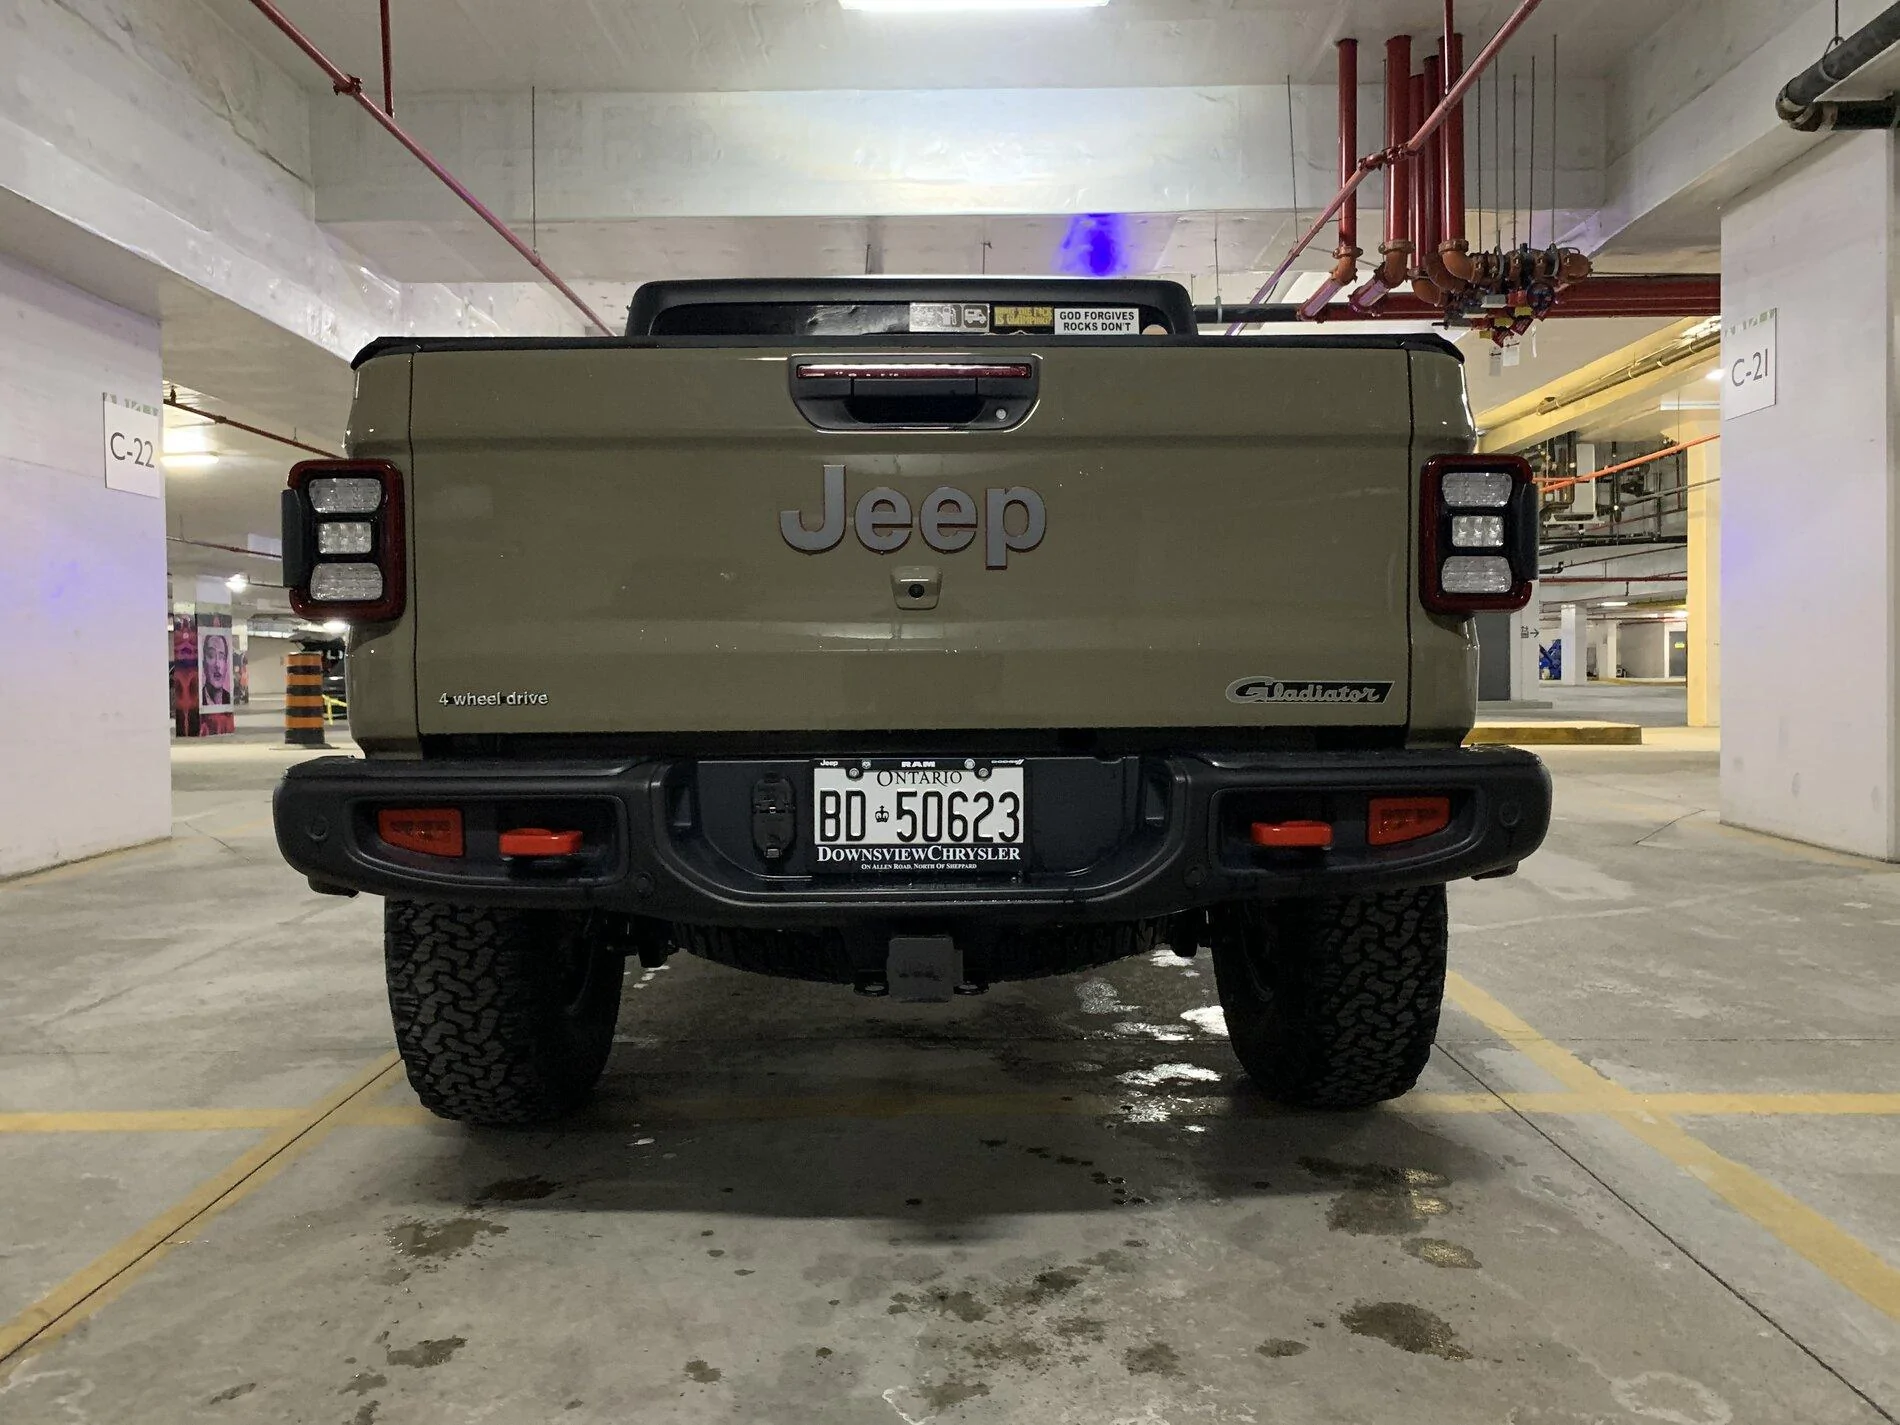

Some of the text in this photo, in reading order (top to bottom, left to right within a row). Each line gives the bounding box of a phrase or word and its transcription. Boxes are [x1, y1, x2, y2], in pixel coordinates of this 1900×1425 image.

[1059, 311, 1135, 321] GOD FORGIVES
[1064, 322, 1131, 332] ROCKS DON'T
[1731, 348, 1768, 387] C-21
[110, 432, 155, 468] C-22
[779, 464, 1046, 570] Jeep
[439, 691, 549, 706] 4 wheel drive
[1225, 676, 1381, 703] Gladiator
[820, 759, 839, 767] Jeep
[876, 770, 962, 787] ONTARIO
[819, 788, 1020, 843] BD 50623
